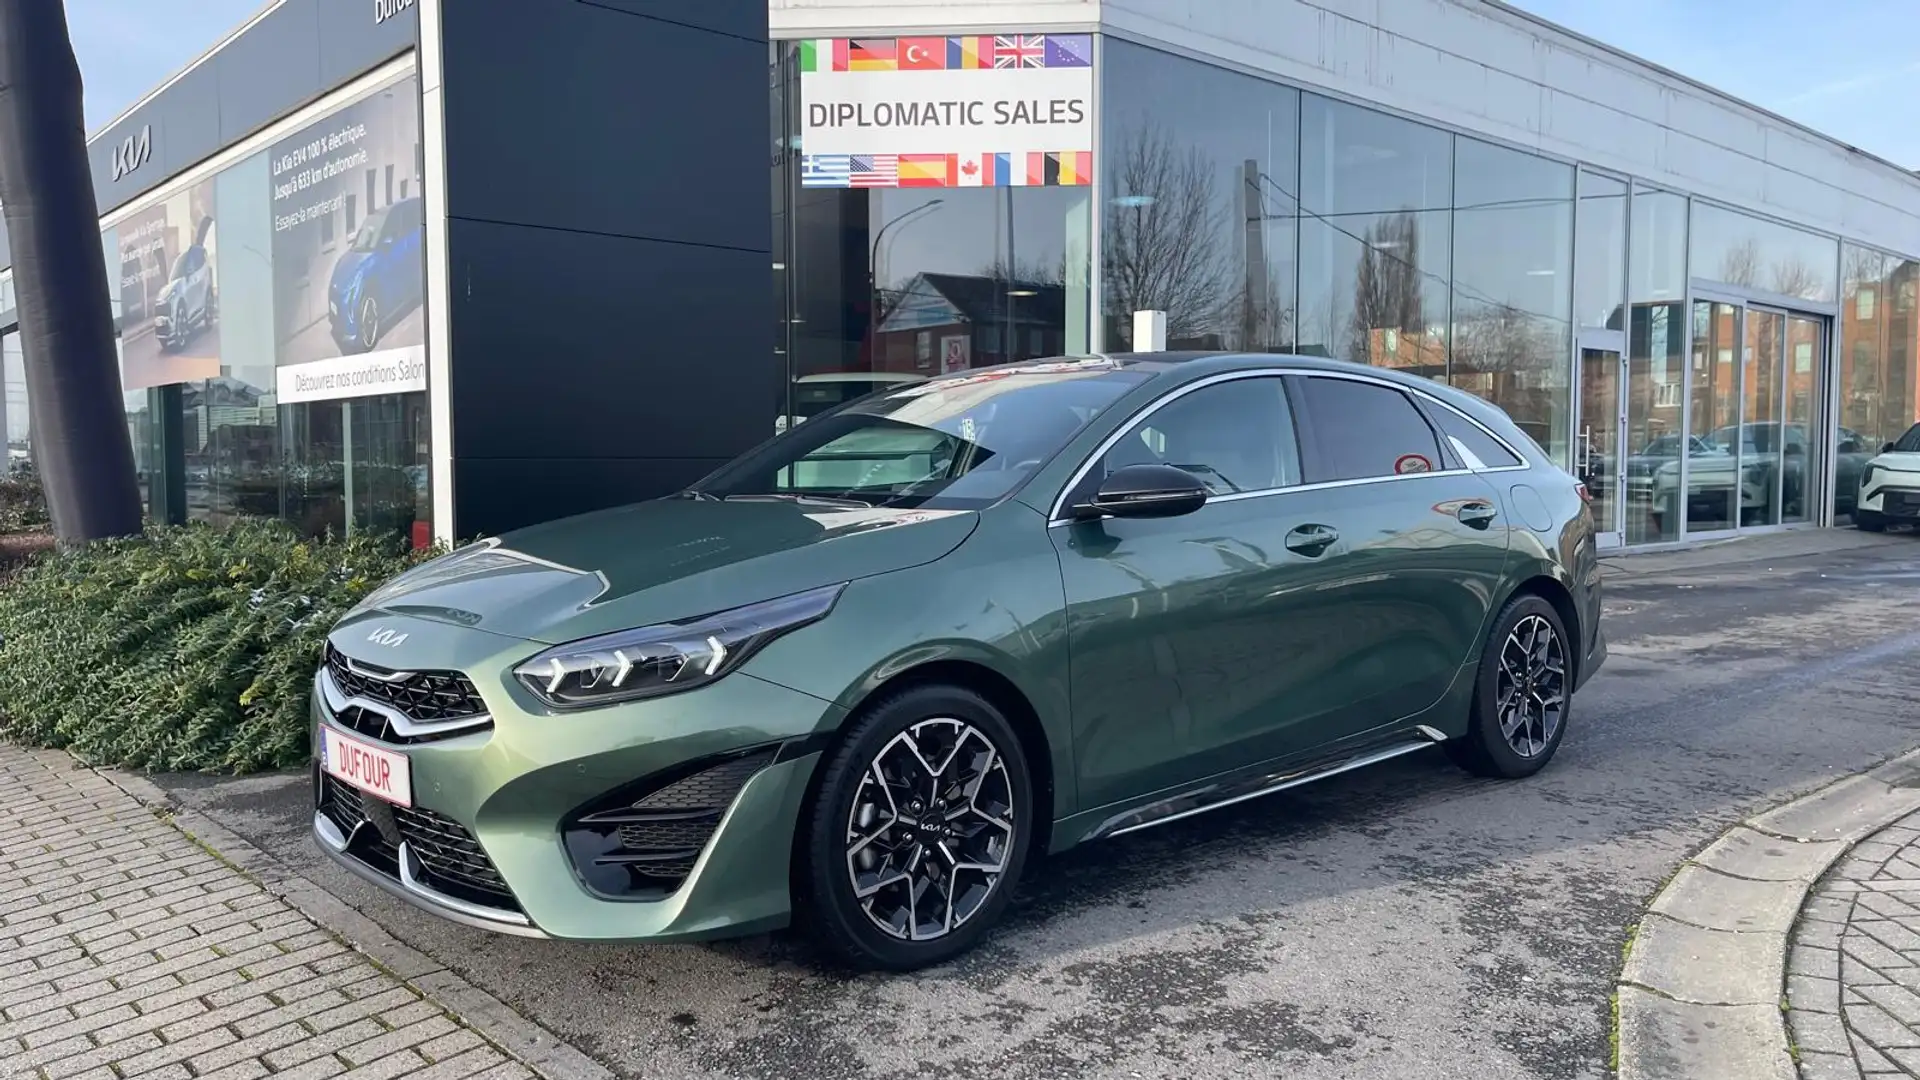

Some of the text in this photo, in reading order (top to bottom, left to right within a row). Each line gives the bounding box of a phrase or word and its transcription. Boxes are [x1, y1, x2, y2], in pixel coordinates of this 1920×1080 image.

[809, 99, 1085, 127] DIPLOMATIC SALES
[112, 125, 151, 182] KIA
[273, 160, 281, 176] La
[282, 155, 293, 172] Kia
[293, 147, 307, 167] EV4
[307, 140, 320, 160] 100
[320, 136, 328, 155] %
[298, 170, 311, 191] 633
[311, 167, 322, 184] km
[295, 357, 425, 392] Découvrez nos conditions Salon
[367, 625, 409, 648] KIA
[338, 741, 392, 793] DUFOUR
[920, 823, 940, 832] KIA
